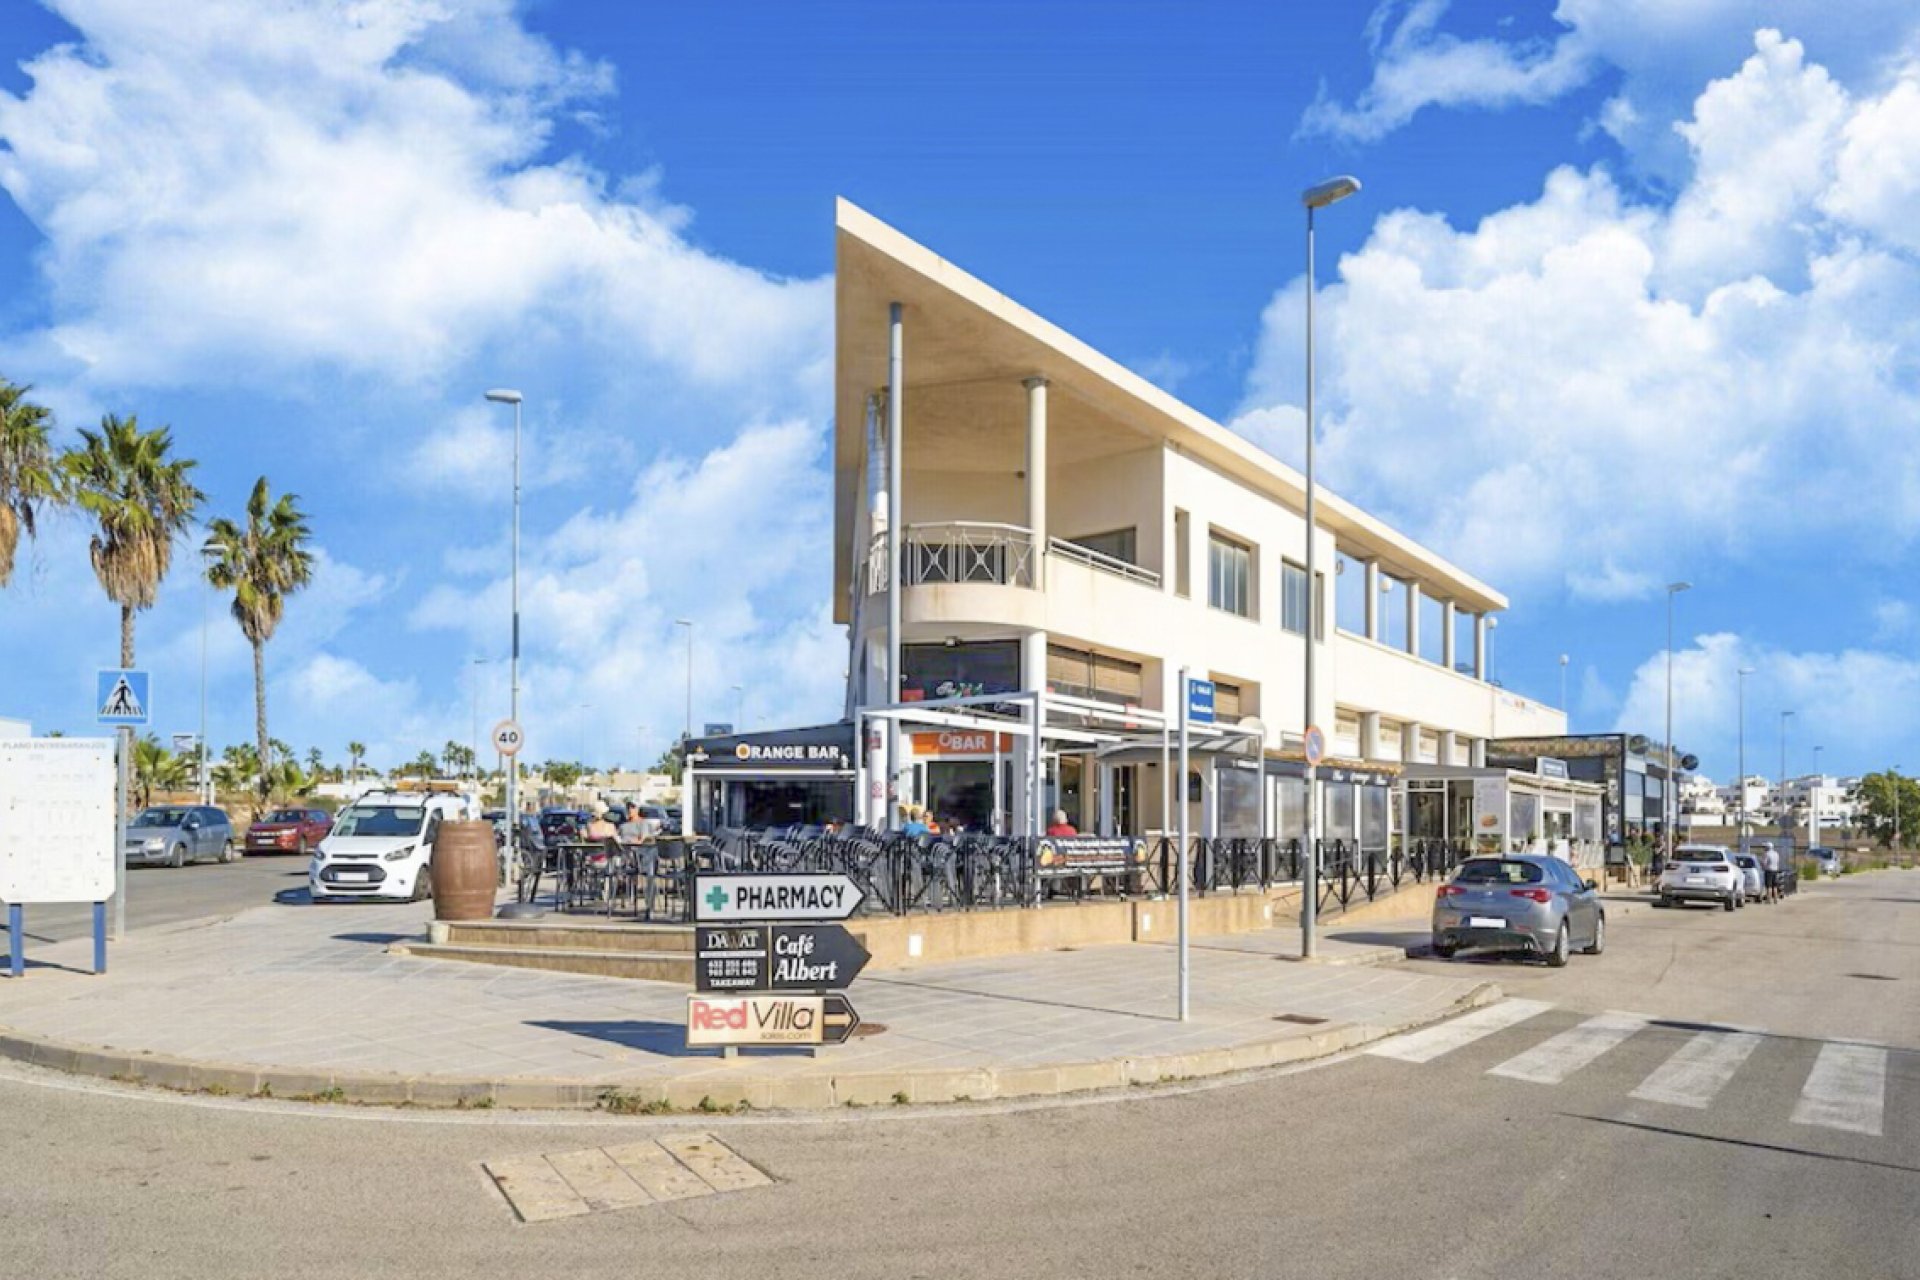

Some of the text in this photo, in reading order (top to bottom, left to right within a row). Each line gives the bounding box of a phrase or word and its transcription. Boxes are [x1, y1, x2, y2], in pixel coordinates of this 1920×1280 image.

[498, 731, 519, 744] 40
[736, 743, 840, 760] ORANGE BAR
[736, 885, 846, 910] PHARMACY
[774, 933, 816, 956] Café
[774, 958, 839, 982] Albert
[692, 1001, 815, 1030] Red Villa
